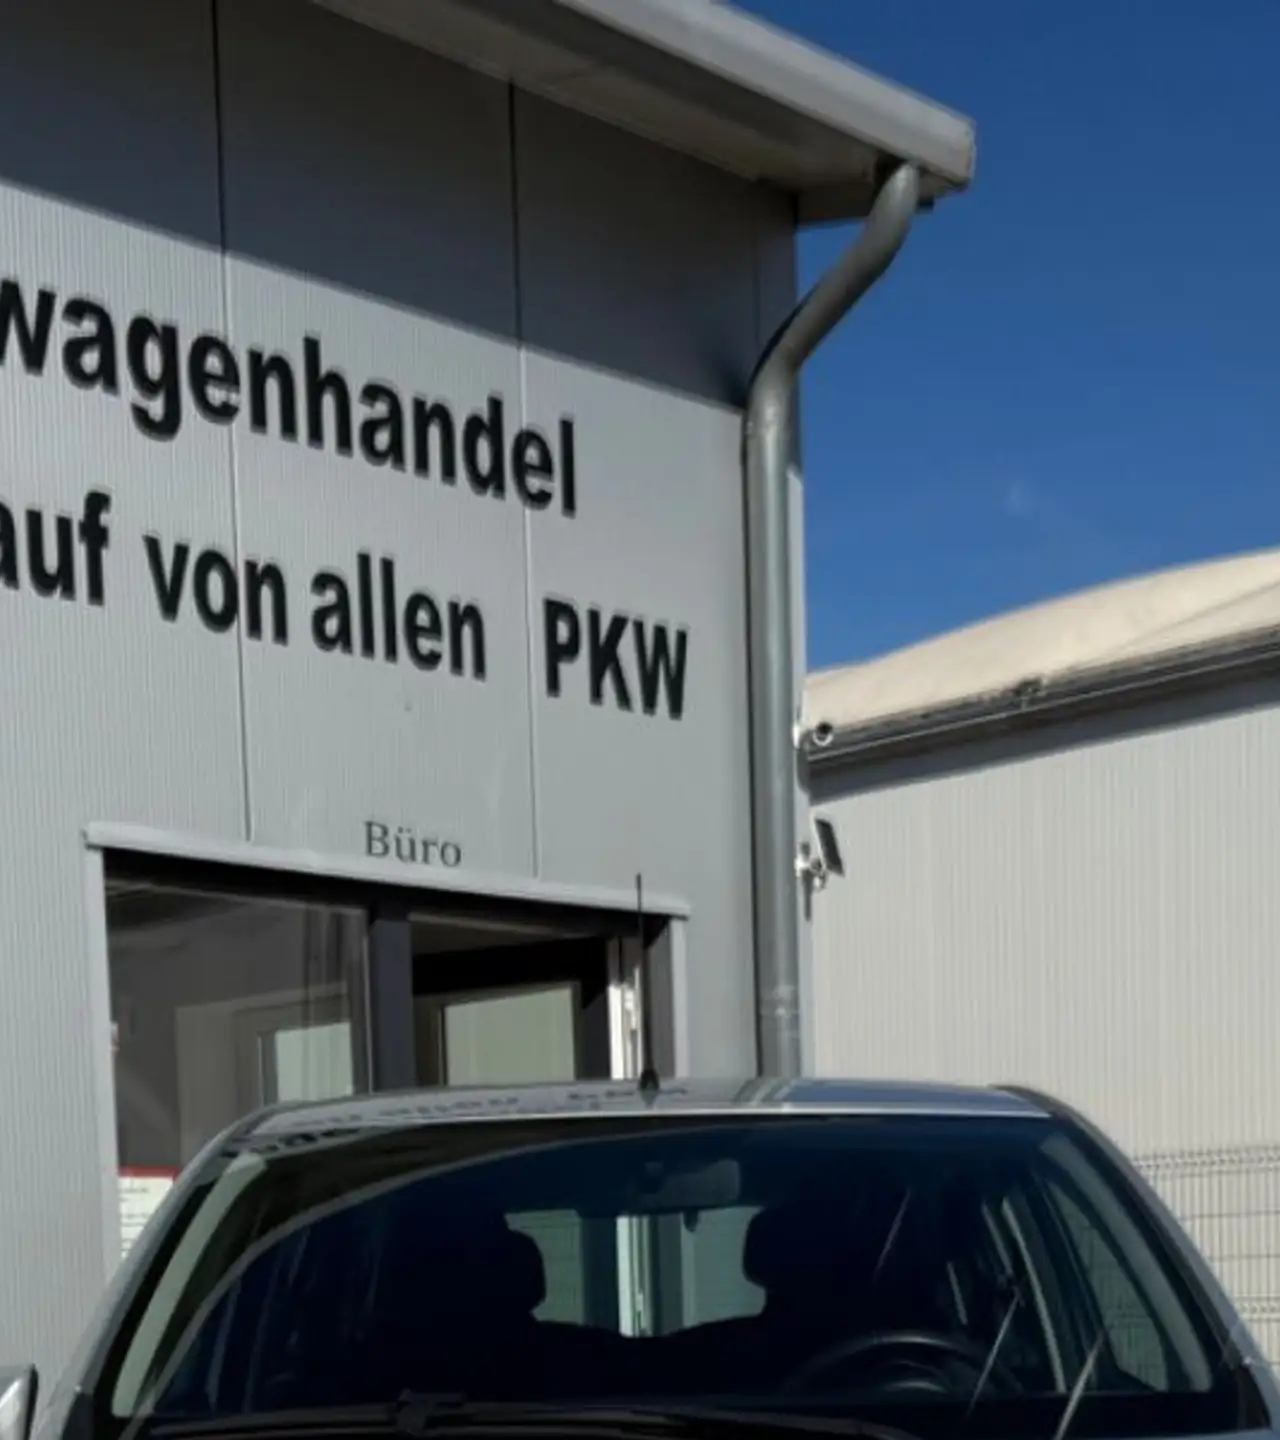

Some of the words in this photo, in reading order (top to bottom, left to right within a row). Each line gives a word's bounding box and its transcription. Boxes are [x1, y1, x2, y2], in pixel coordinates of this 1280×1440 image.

[142, 534, 289, 646] von
[310, 551, 487, 680] allen
[542, 596, 689, 721] PKW
[364, 819, 462, 868] Büro
